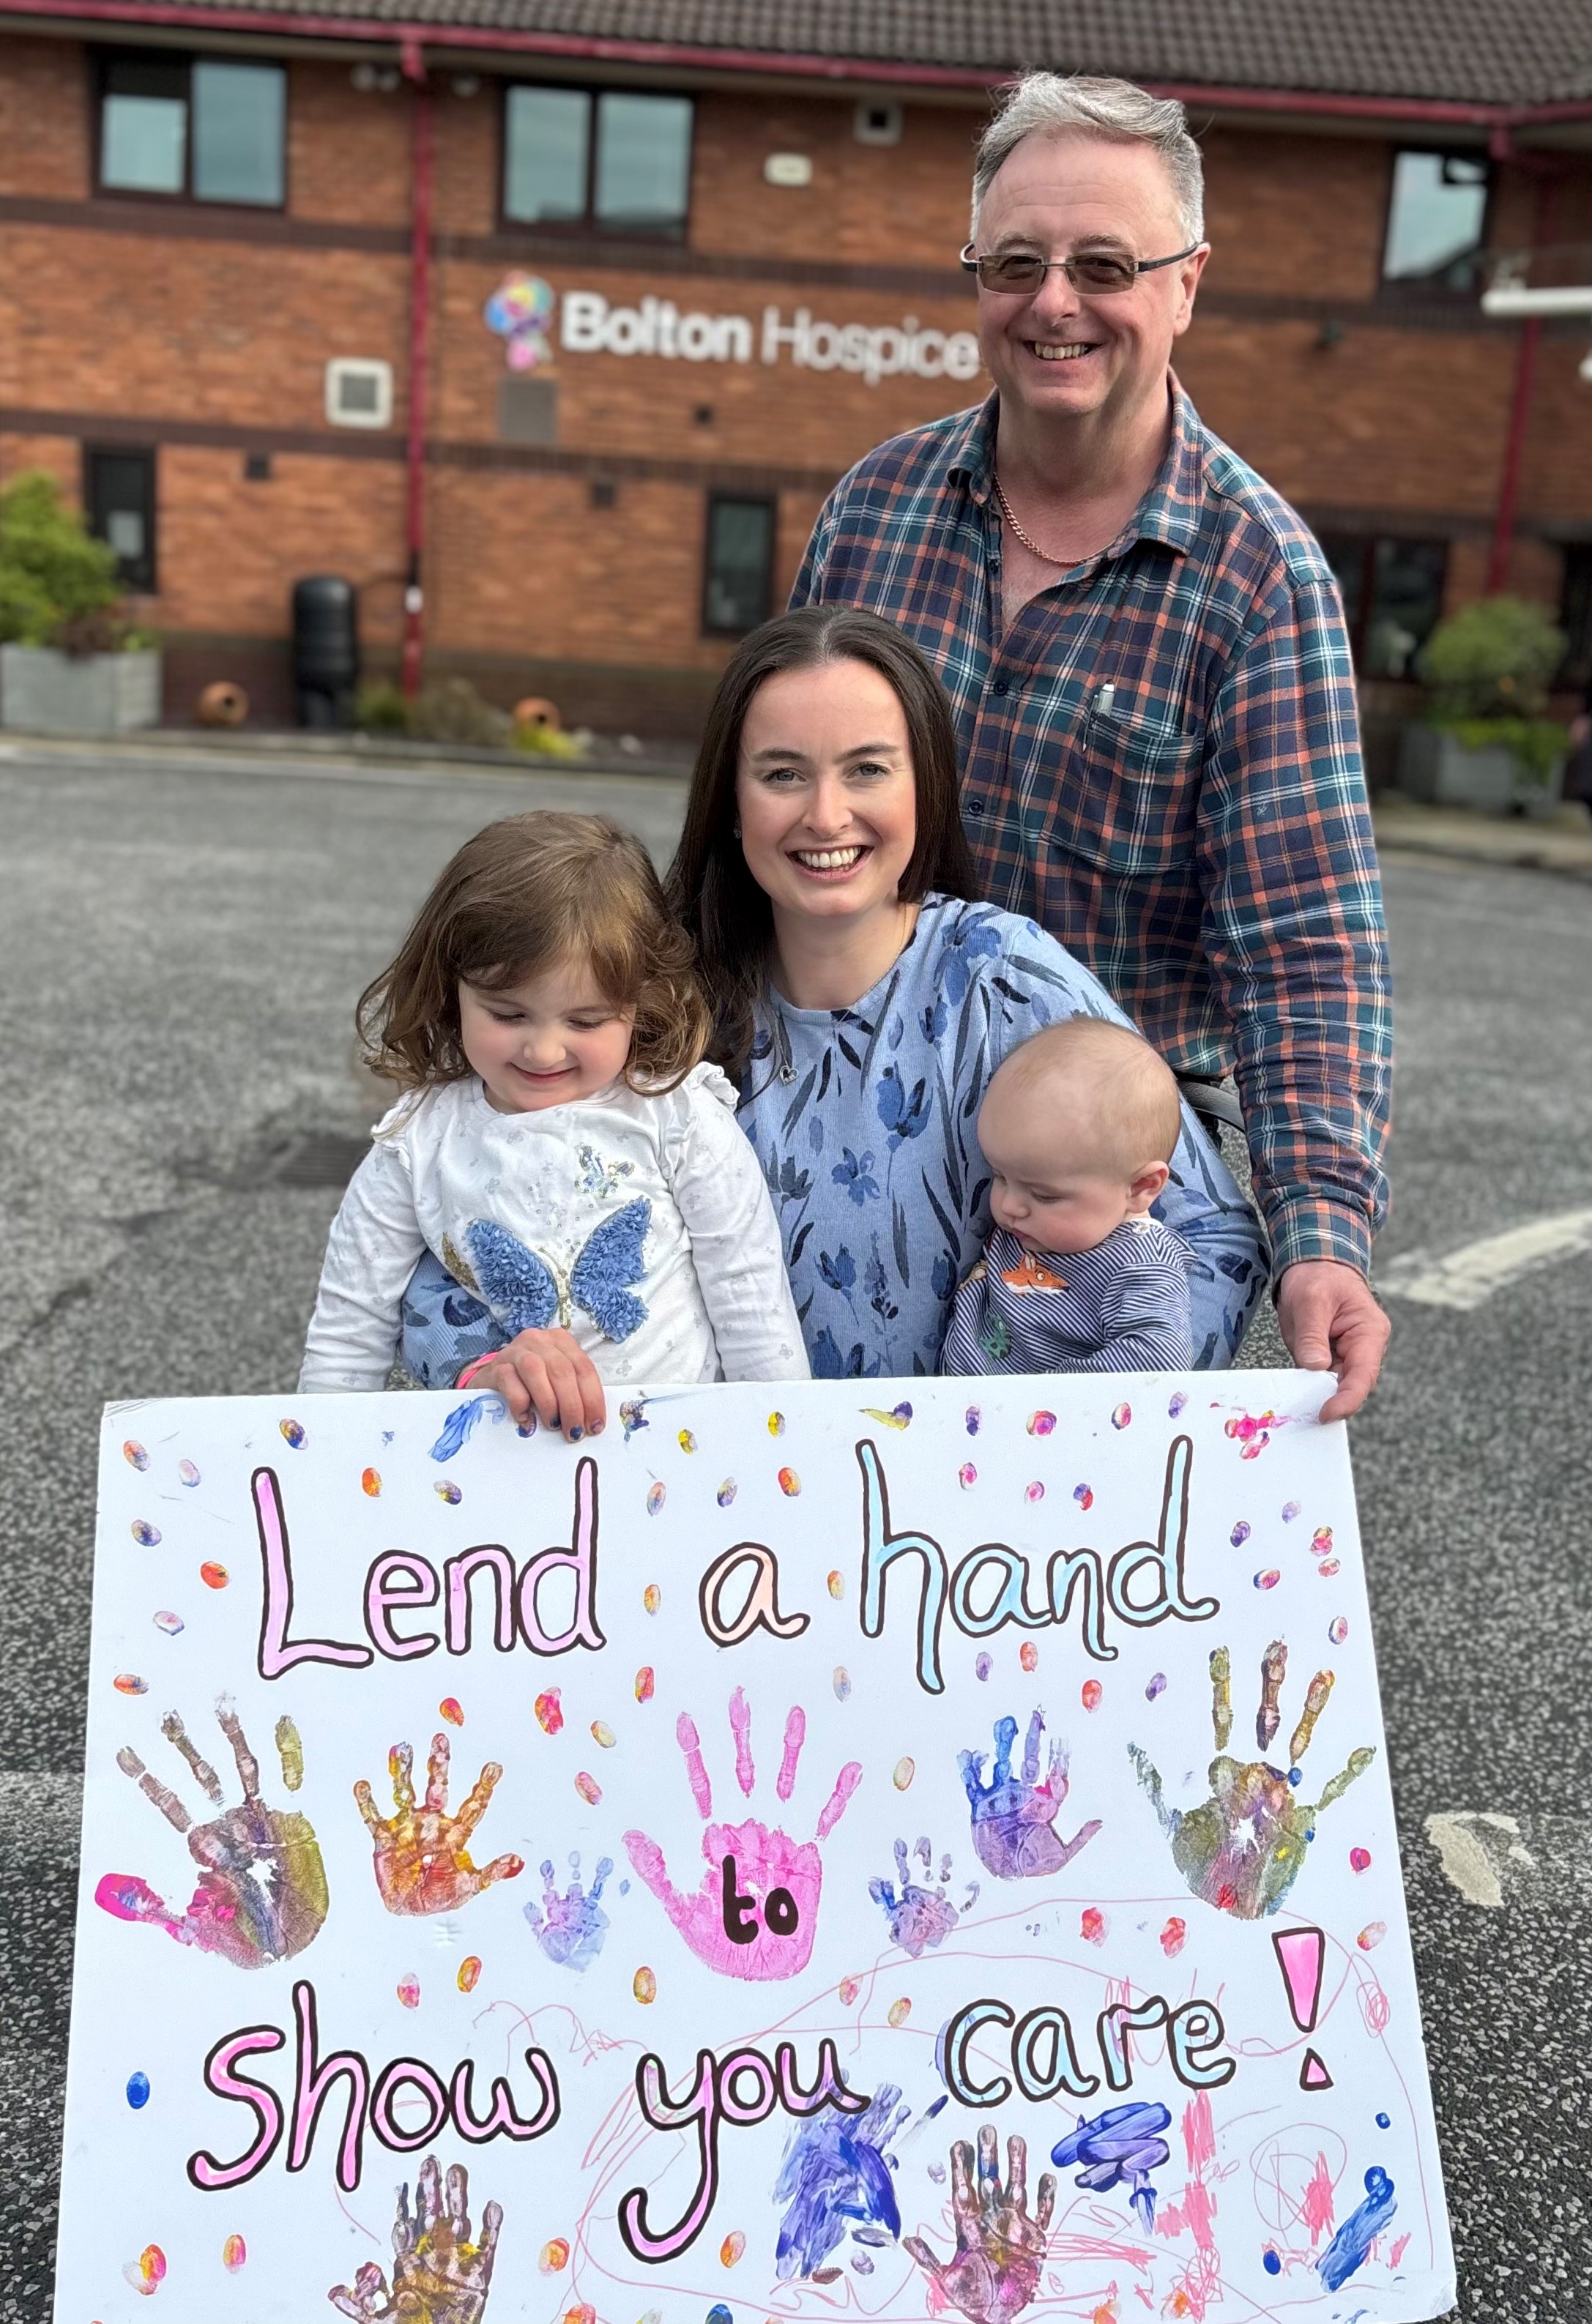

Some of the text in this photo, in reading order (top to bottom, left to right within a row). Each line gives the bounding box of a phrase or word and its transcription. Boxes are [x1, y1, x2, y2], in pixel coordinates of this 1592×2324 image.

[560, 291, 981, 387] Bolton Hospice
[251, 1434, 1221, 1695] Lend a hand
[722, 1854, 800, 1945] to
[617, 2038, 871, 2264] you
